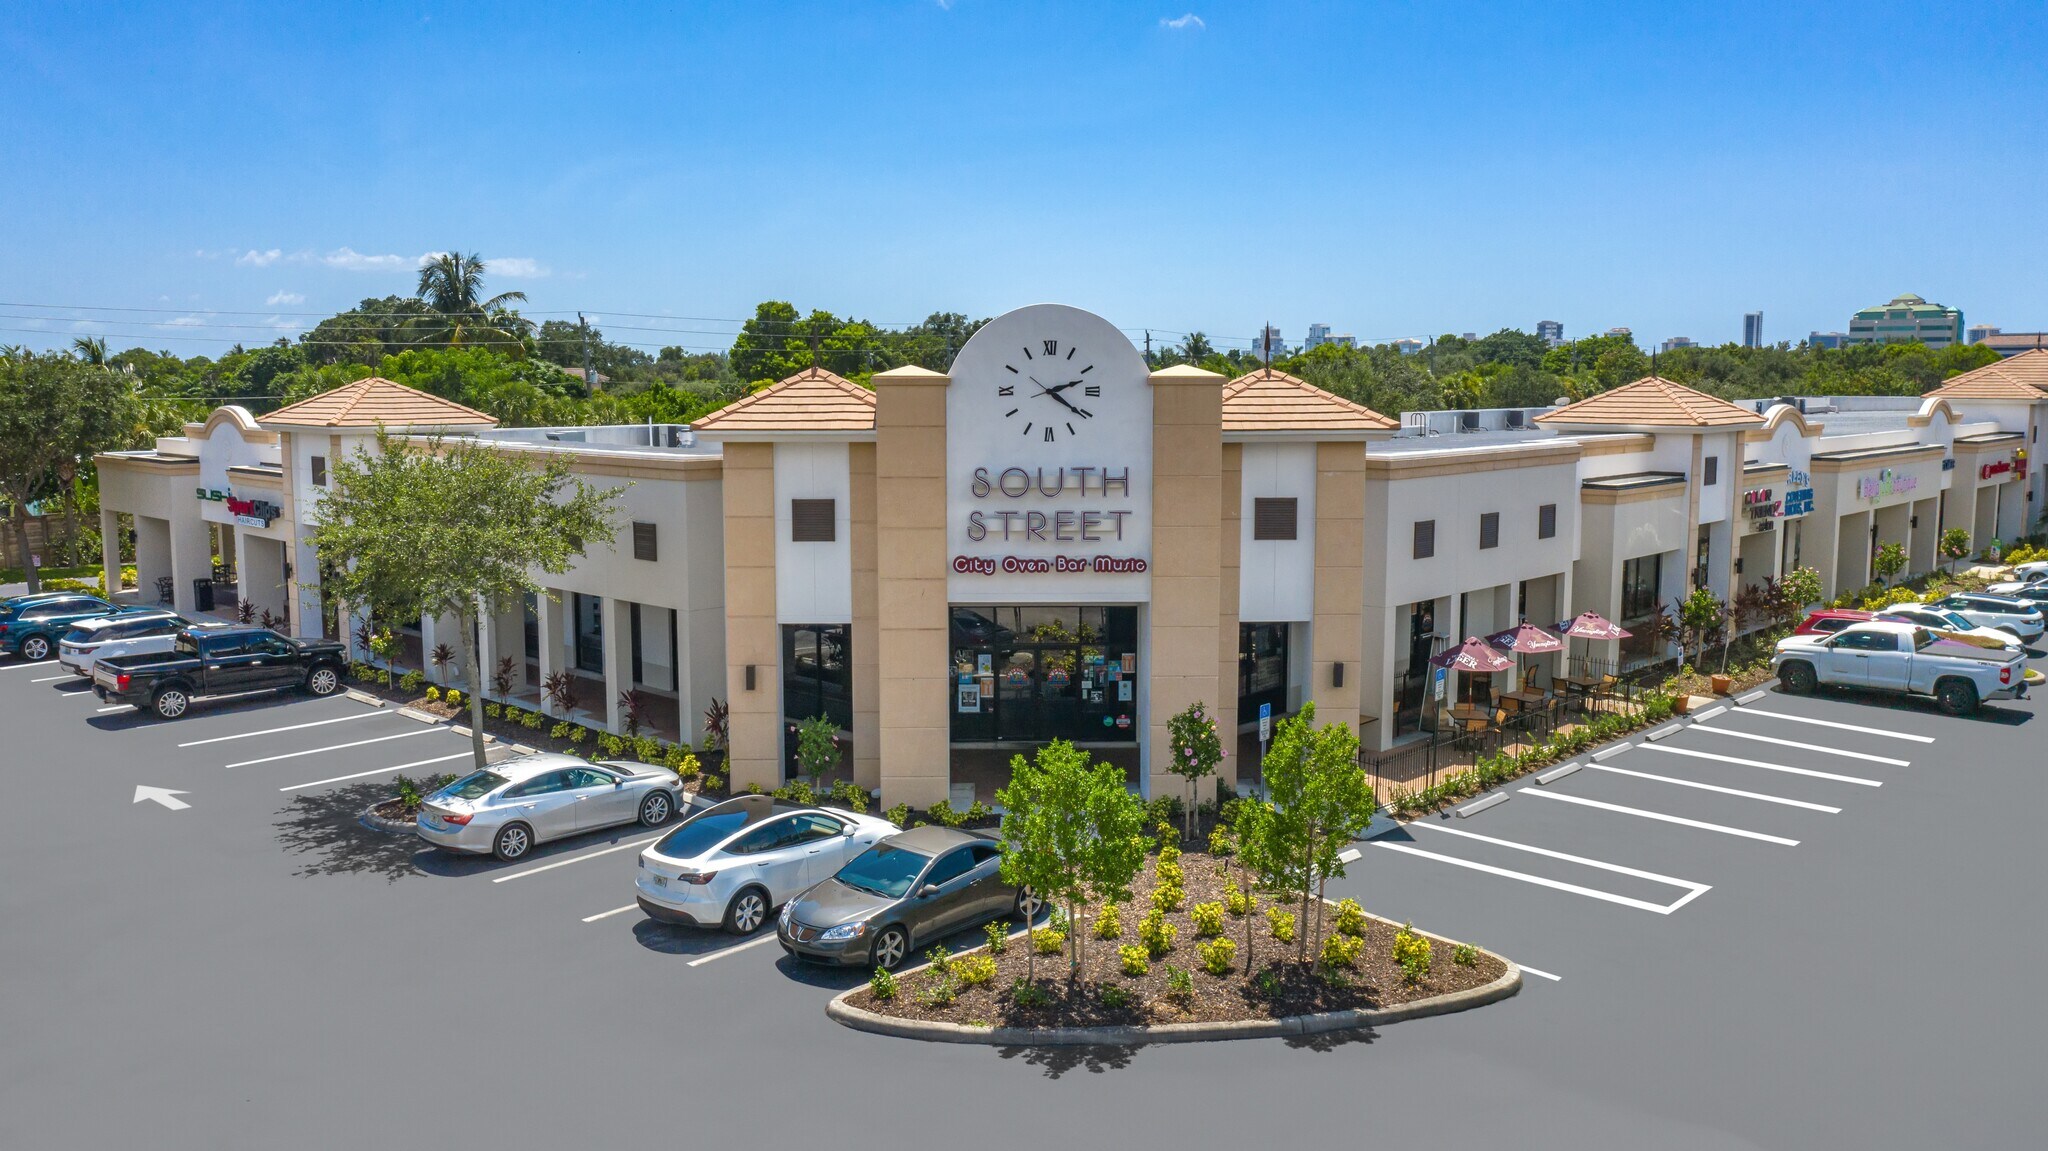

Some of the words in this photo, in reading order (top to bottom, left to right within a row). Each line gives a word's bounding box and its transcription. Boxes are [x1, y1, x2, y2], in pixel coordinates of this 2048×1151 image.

[971, 467, 1129, 498] SOUTH
[238, 516, 265, 528] HAIRCUTS
[967, 510, 1132, 542] STREET
[953, 556, 995, 575] City
[1002, 556, 1049, 573] Oven
[1056, 555, 1087, 572] Bar
[1094, 555, 1147, 573] Music
